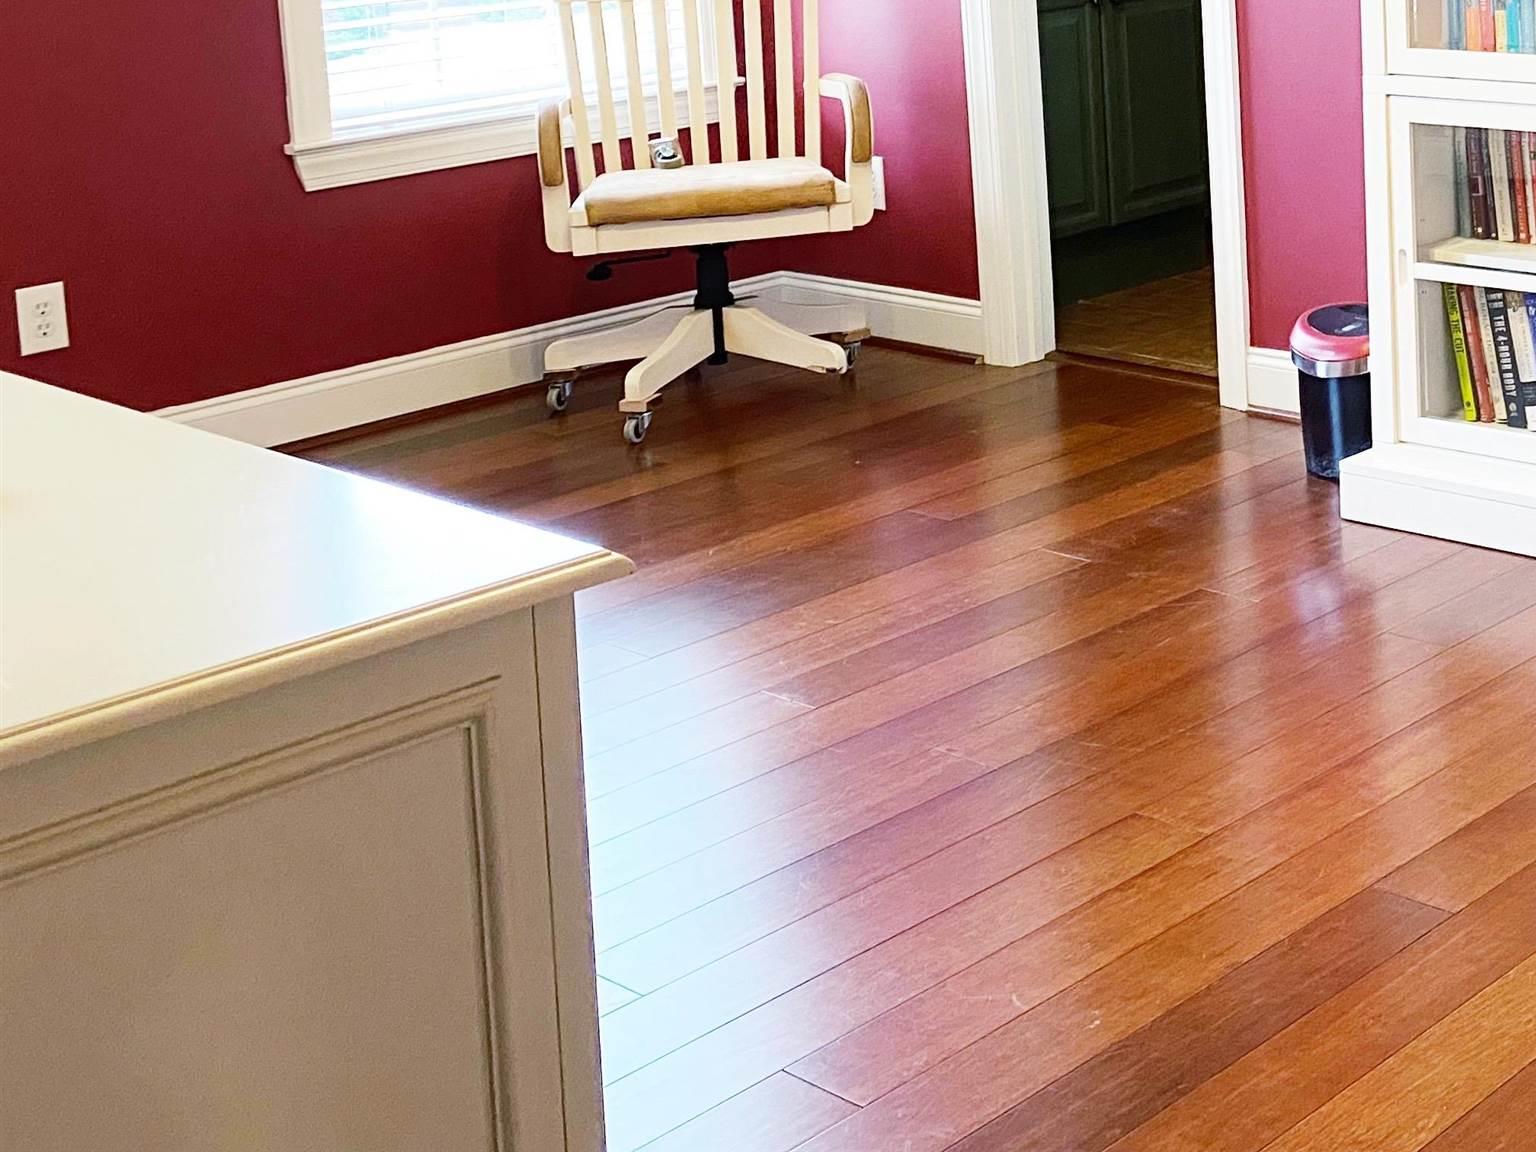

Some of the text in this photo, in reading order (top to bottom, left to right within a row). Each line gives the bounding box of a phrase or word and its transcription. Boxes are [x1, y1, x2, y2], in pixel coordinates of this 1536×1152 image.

[1450, 319, 1461, 336] THE
[1454, 337, 1464, 354] CUT
[1493, 315, 1517, 398] THE 4-HOUR BODY
